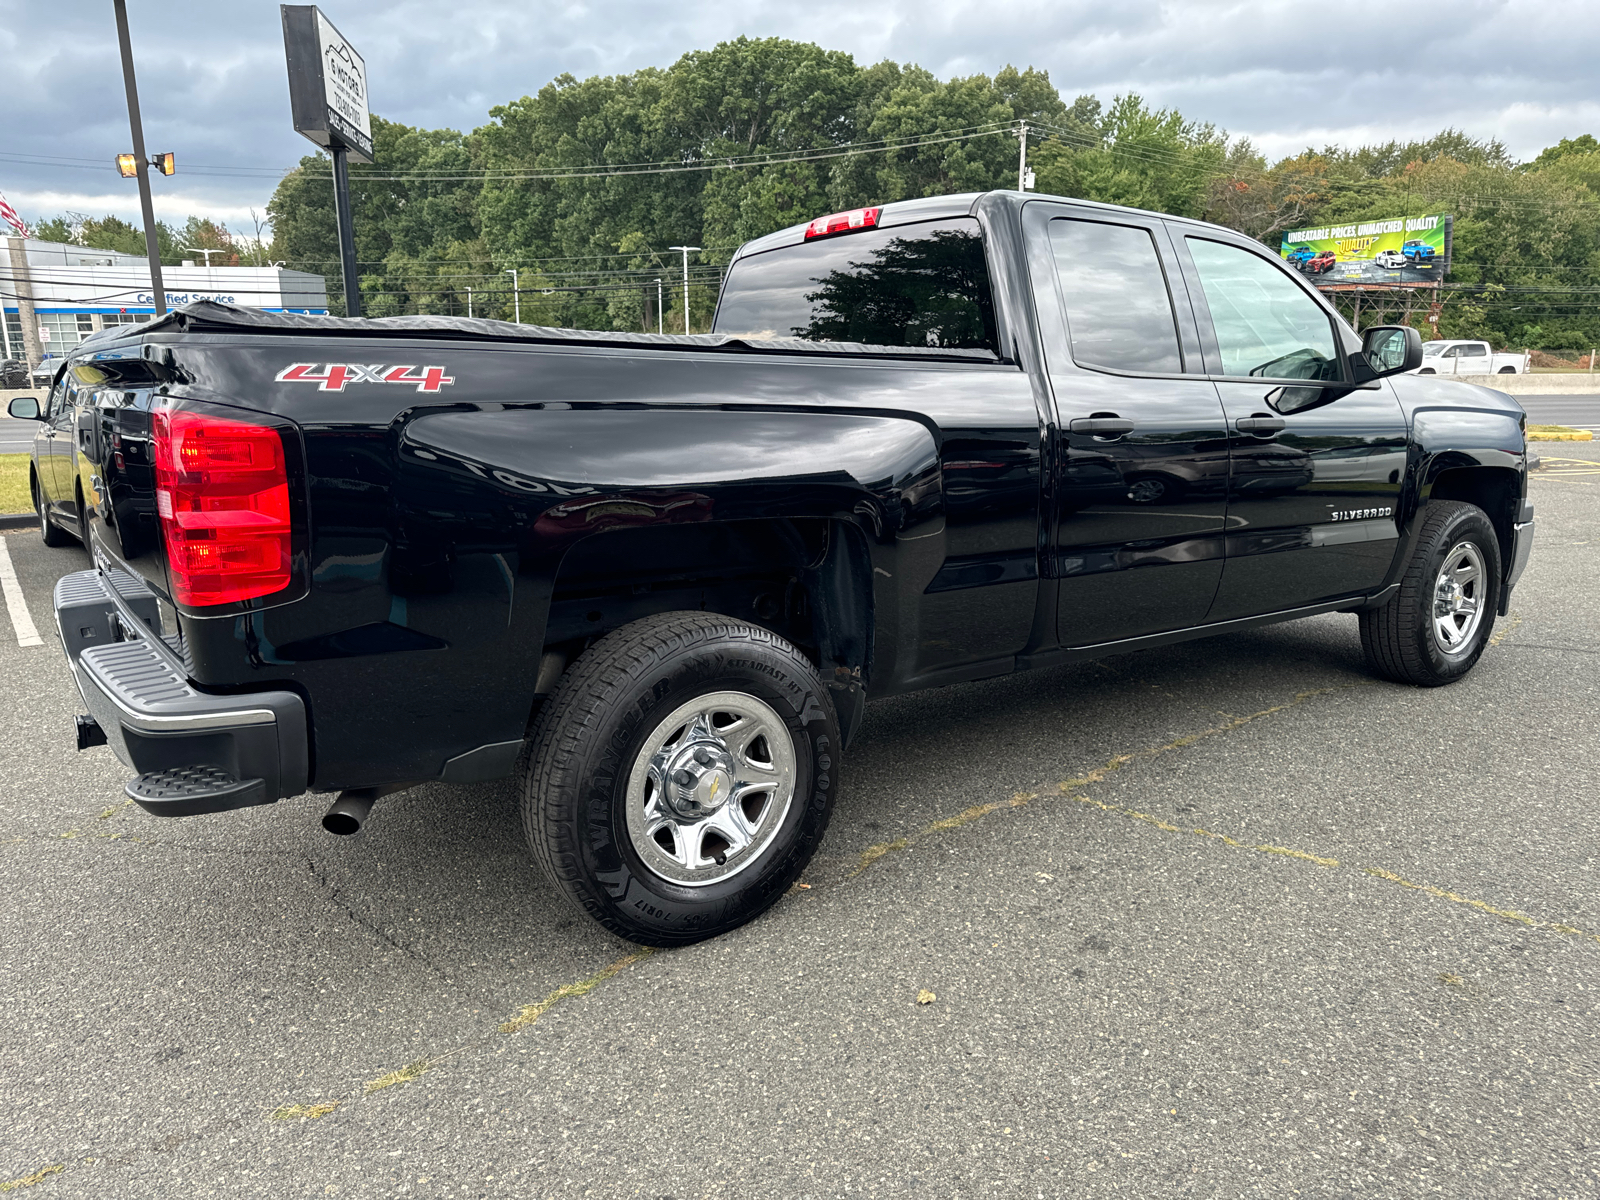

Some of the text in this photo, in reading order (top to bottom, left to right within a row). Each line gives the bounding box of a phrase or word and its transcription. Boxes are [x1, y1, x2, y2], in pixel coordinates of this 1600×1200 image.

[337, 64, 359, 97] MOTORS
[1288, 216, 1439, 243] UNBEATABLE PRICES, UNMATCHED QUALITY
[1339, 237, 1374, 255] QUALITY
[137, 293, 188, 304] Cefied
[1331, 506, 1391, 521] SILVERADO
[726, 657, 803, 695] STEADFAST HT
[587, 677, 670, 851] WRANGLER
